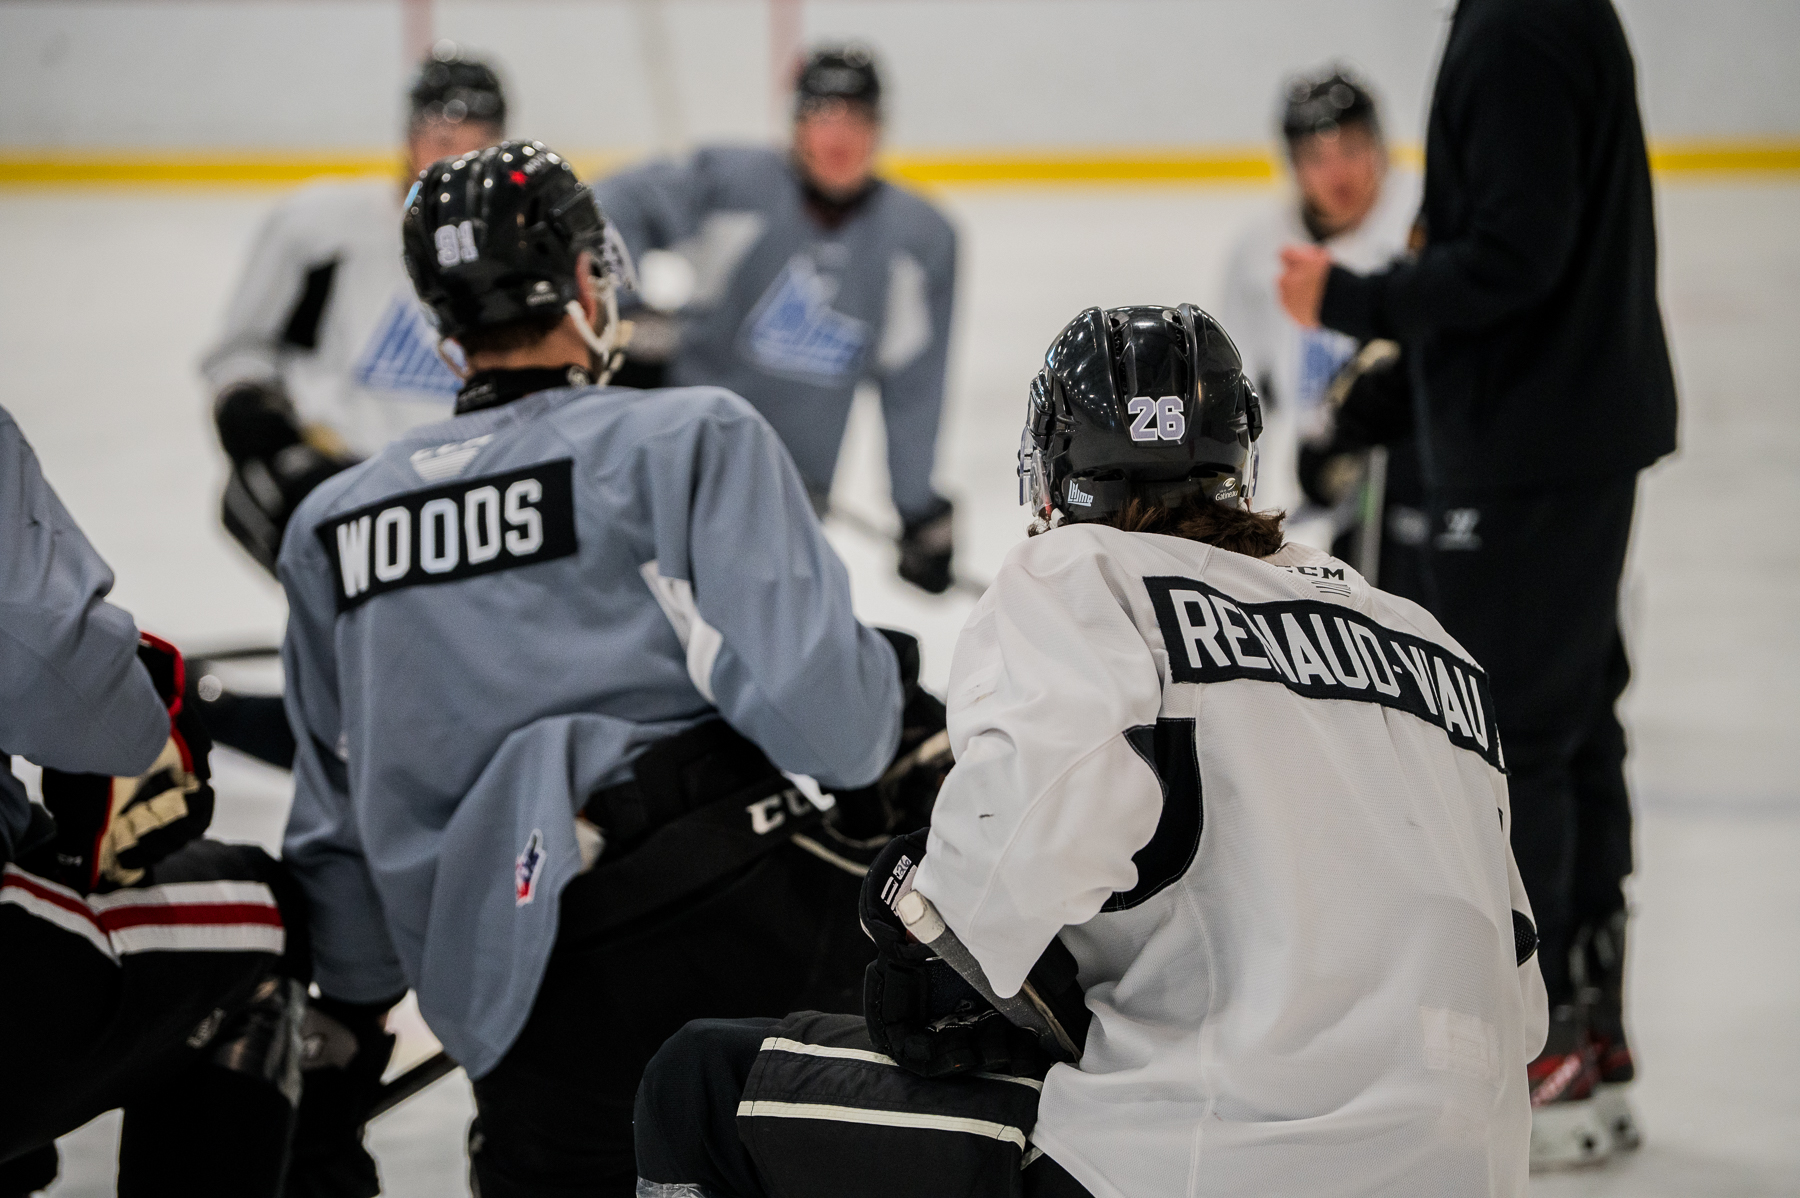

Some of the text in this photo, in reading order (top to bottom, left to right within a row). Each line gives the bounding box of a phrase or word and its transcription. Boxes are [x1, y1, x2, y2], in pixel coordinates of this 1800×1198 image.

[1128, 396, 1185, 441] 26
[337, 478, 544, 599] WOODS
[746, 787, 816, 835] CC
